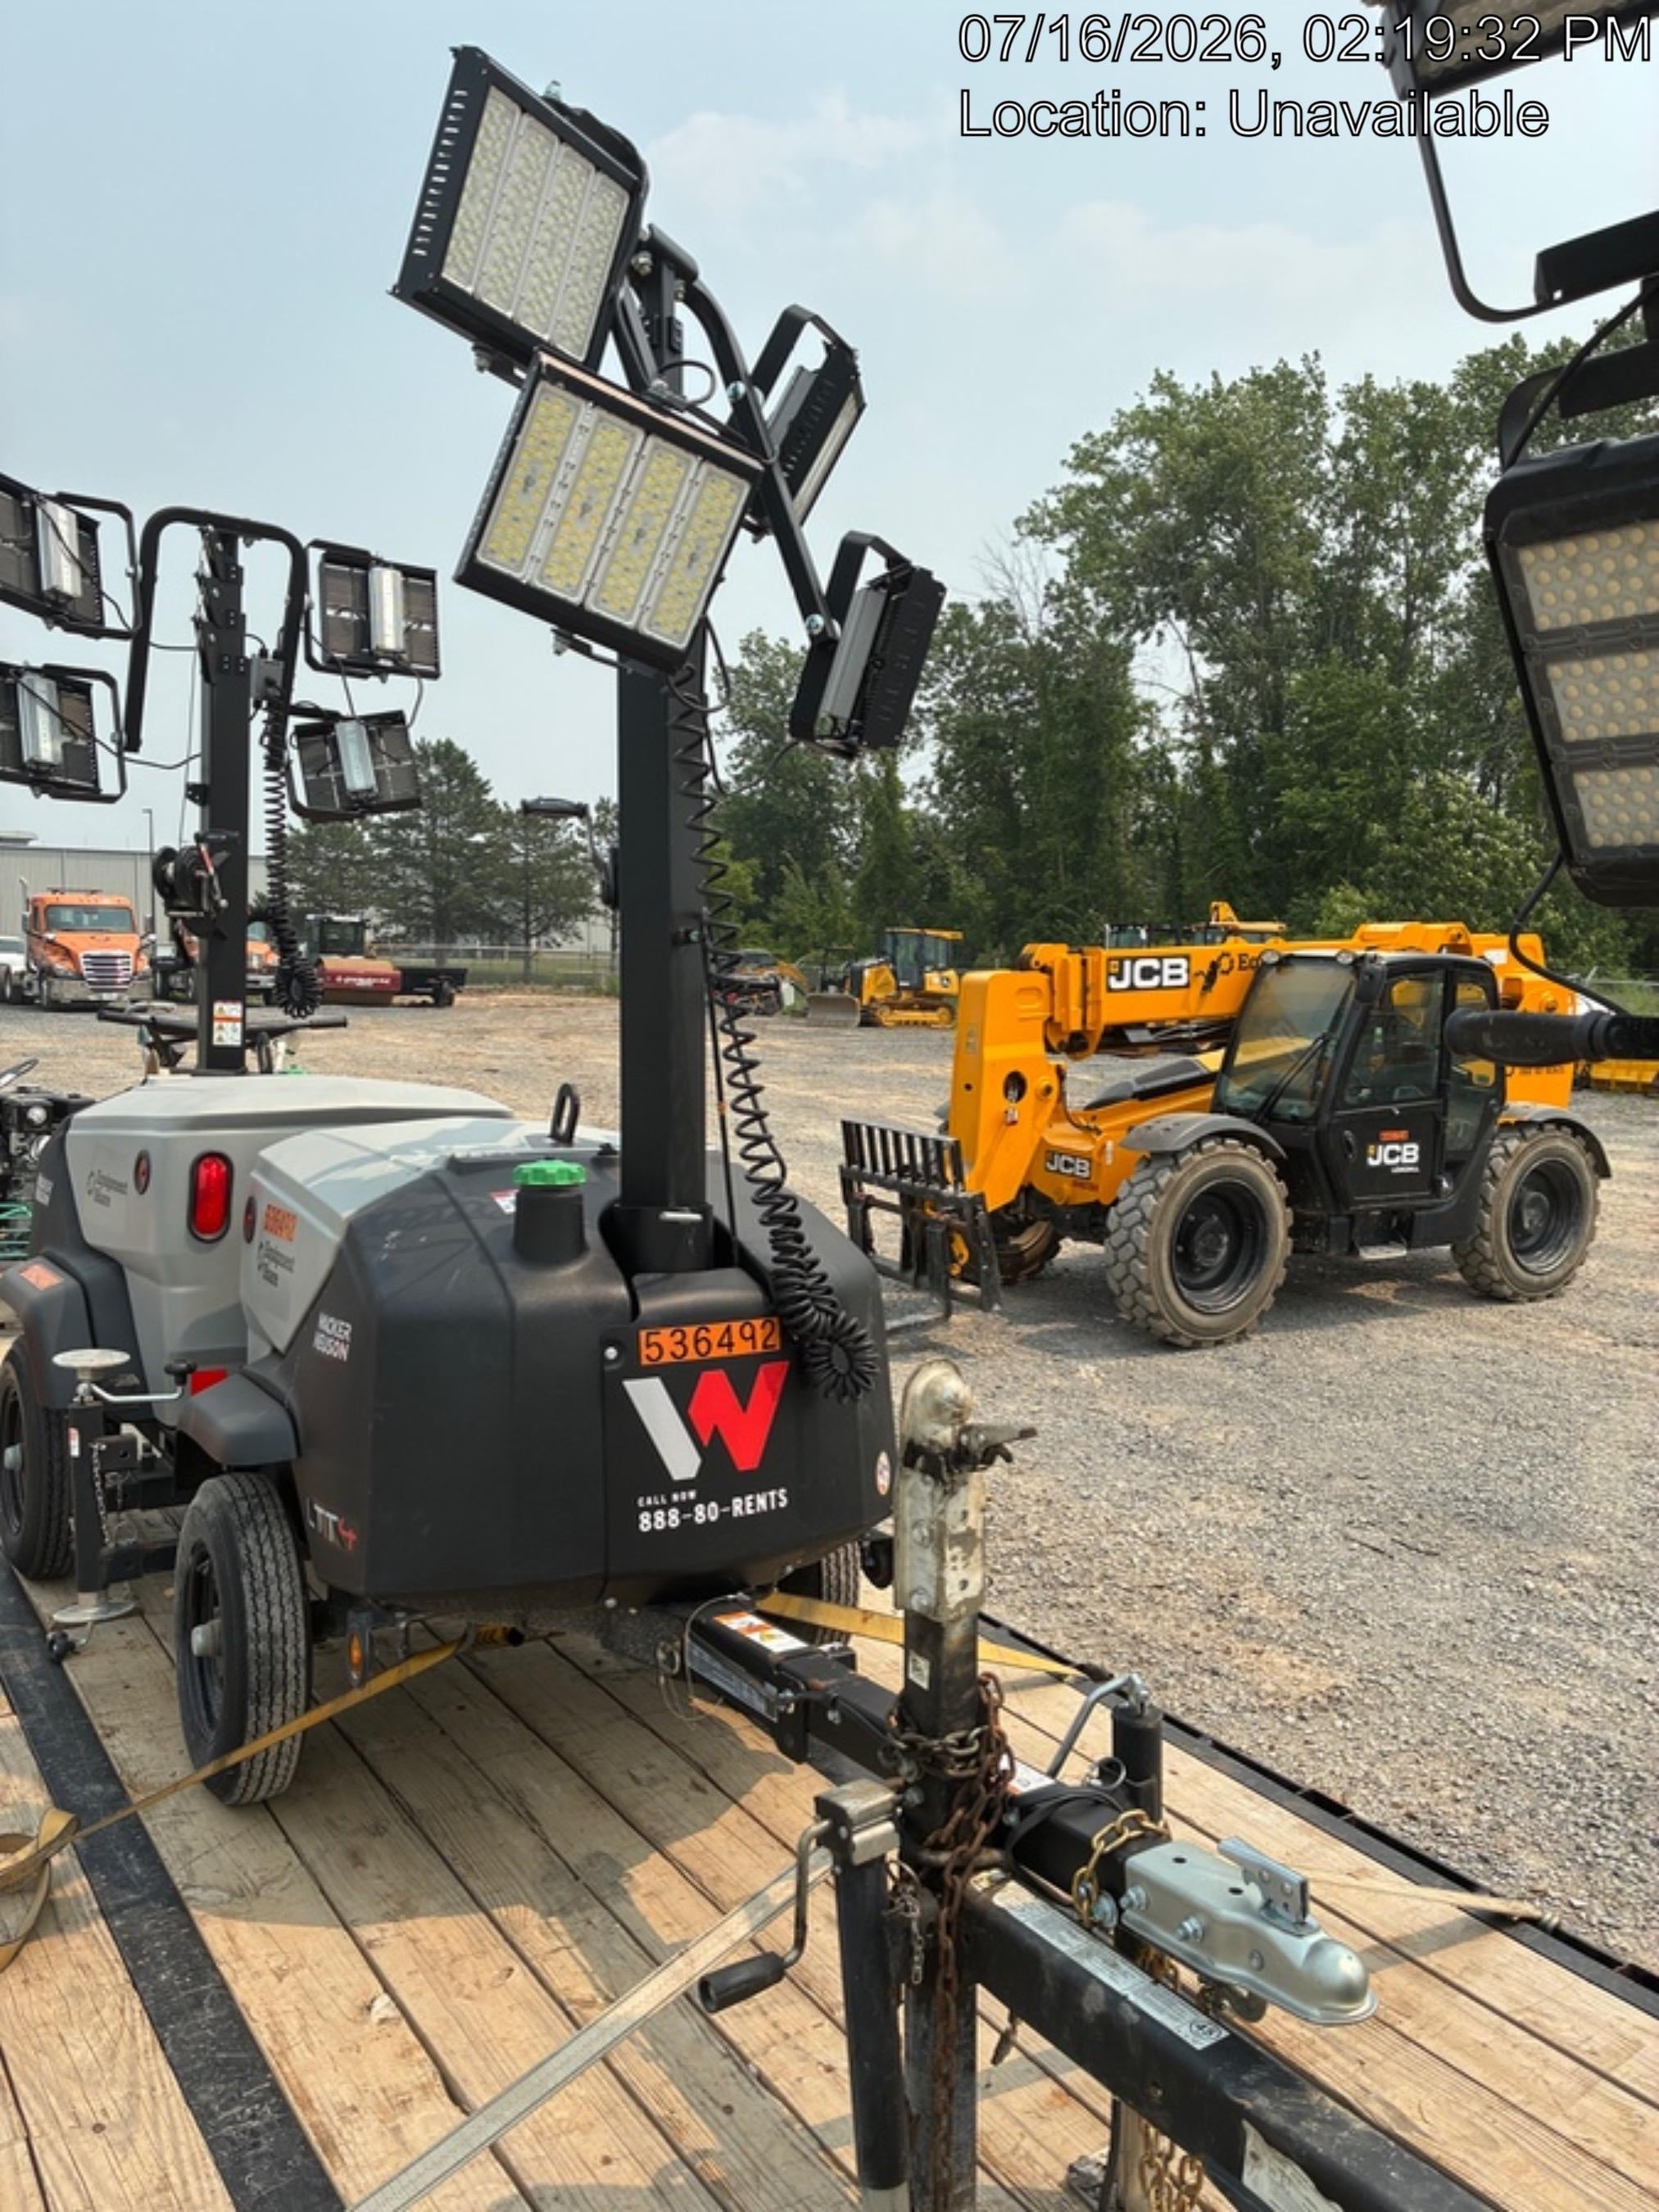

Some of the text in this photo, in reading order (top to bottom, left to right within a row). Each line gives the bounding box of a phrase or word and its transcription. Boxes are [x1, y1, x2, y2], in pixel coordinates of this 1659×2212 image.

[1108, 957, 1188, 989] JCB
[1046, 1154, 1090, 1178] JCB
[1367, 1142, 1419, 1166] JCB
[644, 1319, 777, 1362] 536492
[637, 1494, 668, 1508] CALL
[637, 1487, 788, 1533] 888-80-RENTS
